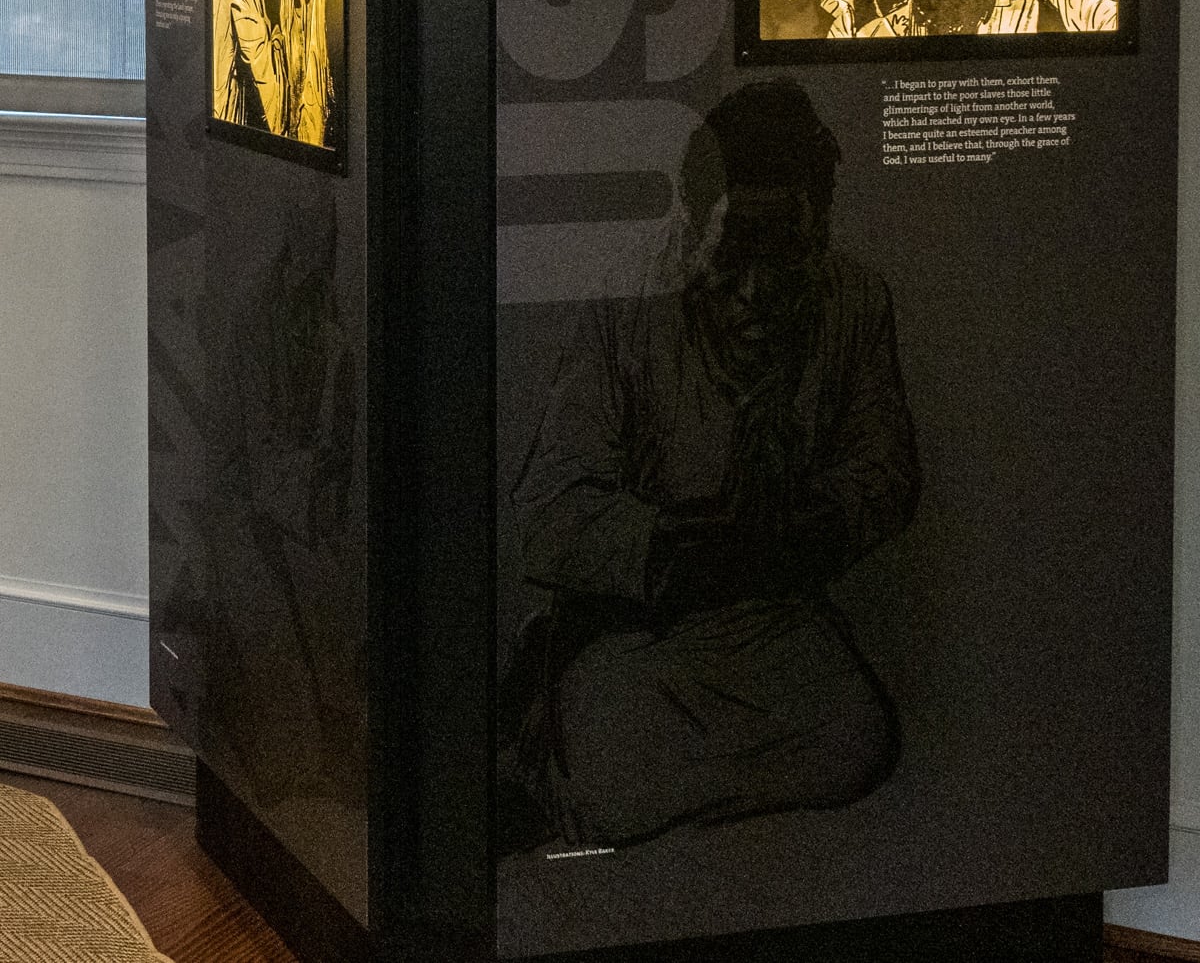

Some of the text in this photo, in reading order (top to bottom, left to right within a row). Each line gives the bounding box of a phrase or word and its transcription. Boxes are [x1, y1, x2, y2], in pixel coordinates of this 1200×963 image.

[882, 155, 902, 167] God,
[909, 157, 926, 165] was
[928, 153, 954, 164] useful
